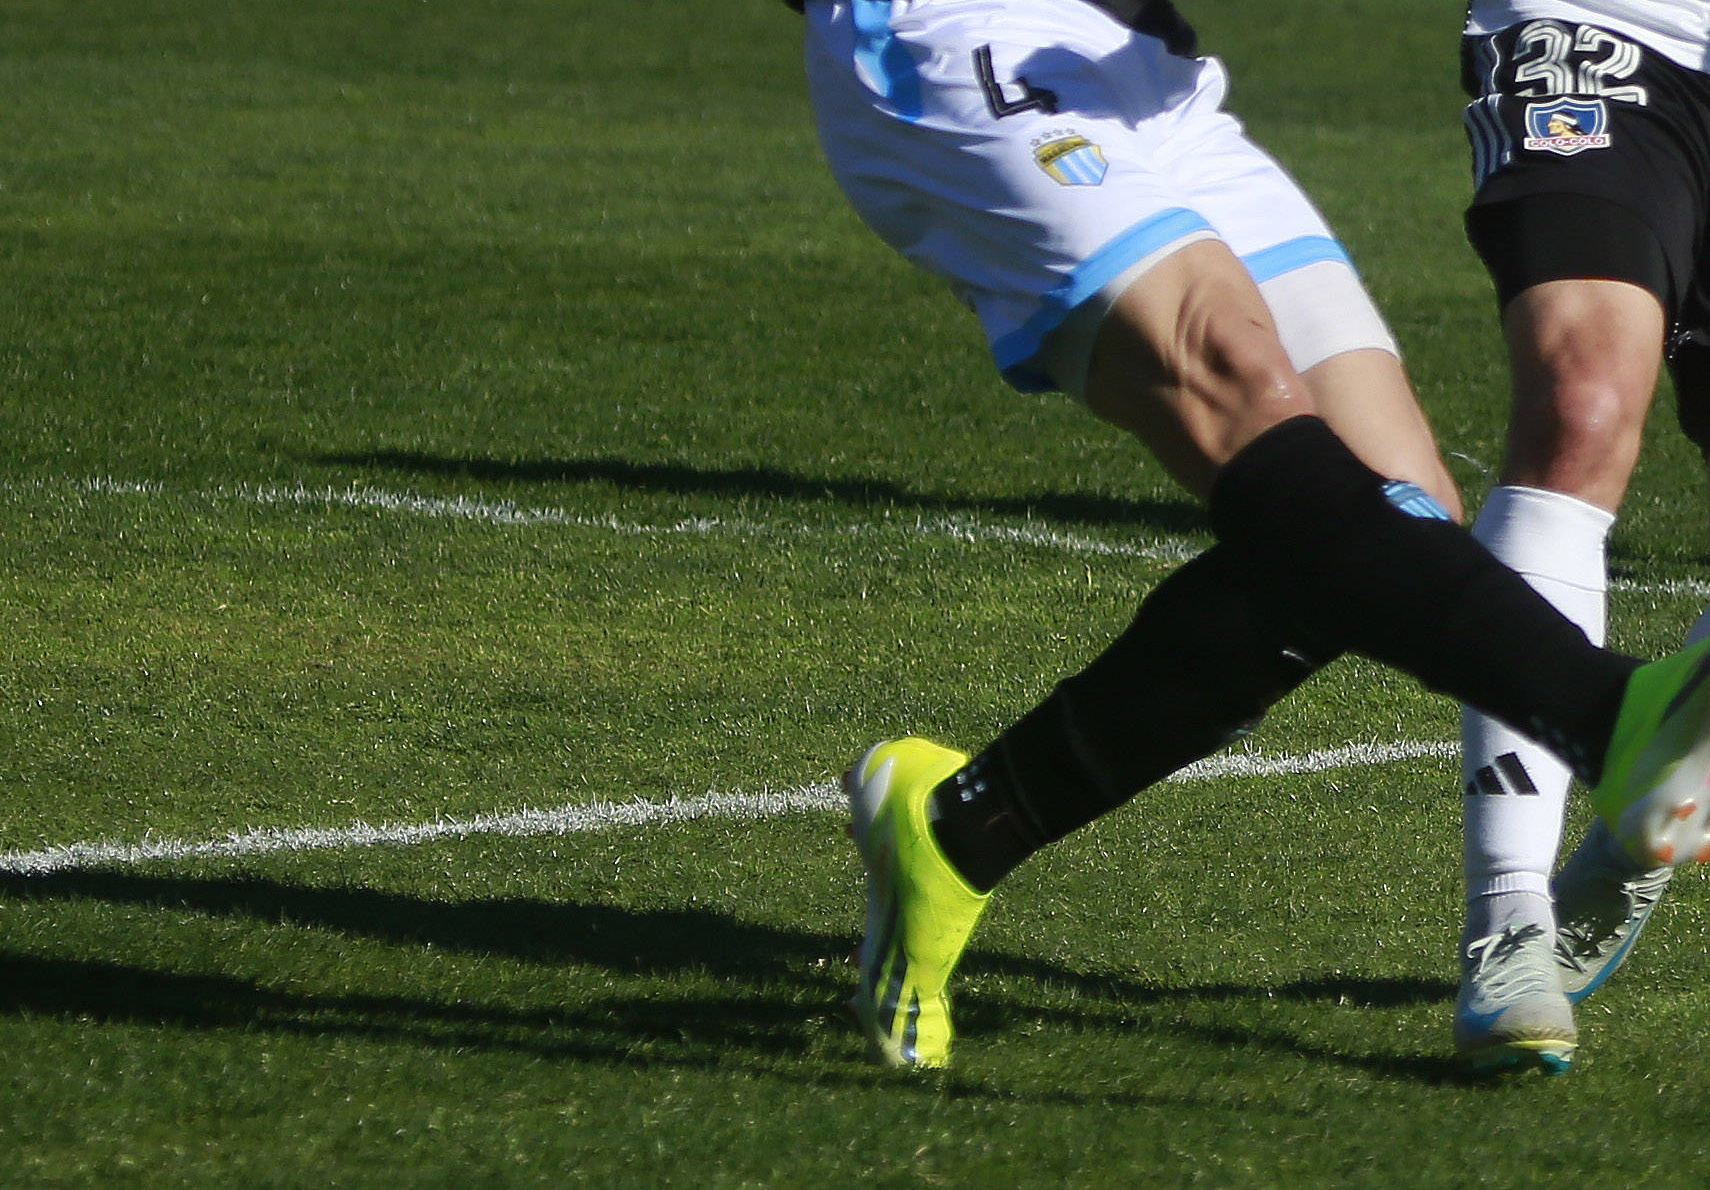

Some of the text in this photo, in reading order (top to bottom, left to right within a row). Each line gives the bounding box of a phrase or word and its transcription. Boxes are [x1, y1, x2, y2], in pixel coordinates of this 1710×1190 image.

[971, 42, 1059, 121] 4
[1512, 19, 1648, 106] 32
[1530, 136, 1604, 148] COLO-COLO
